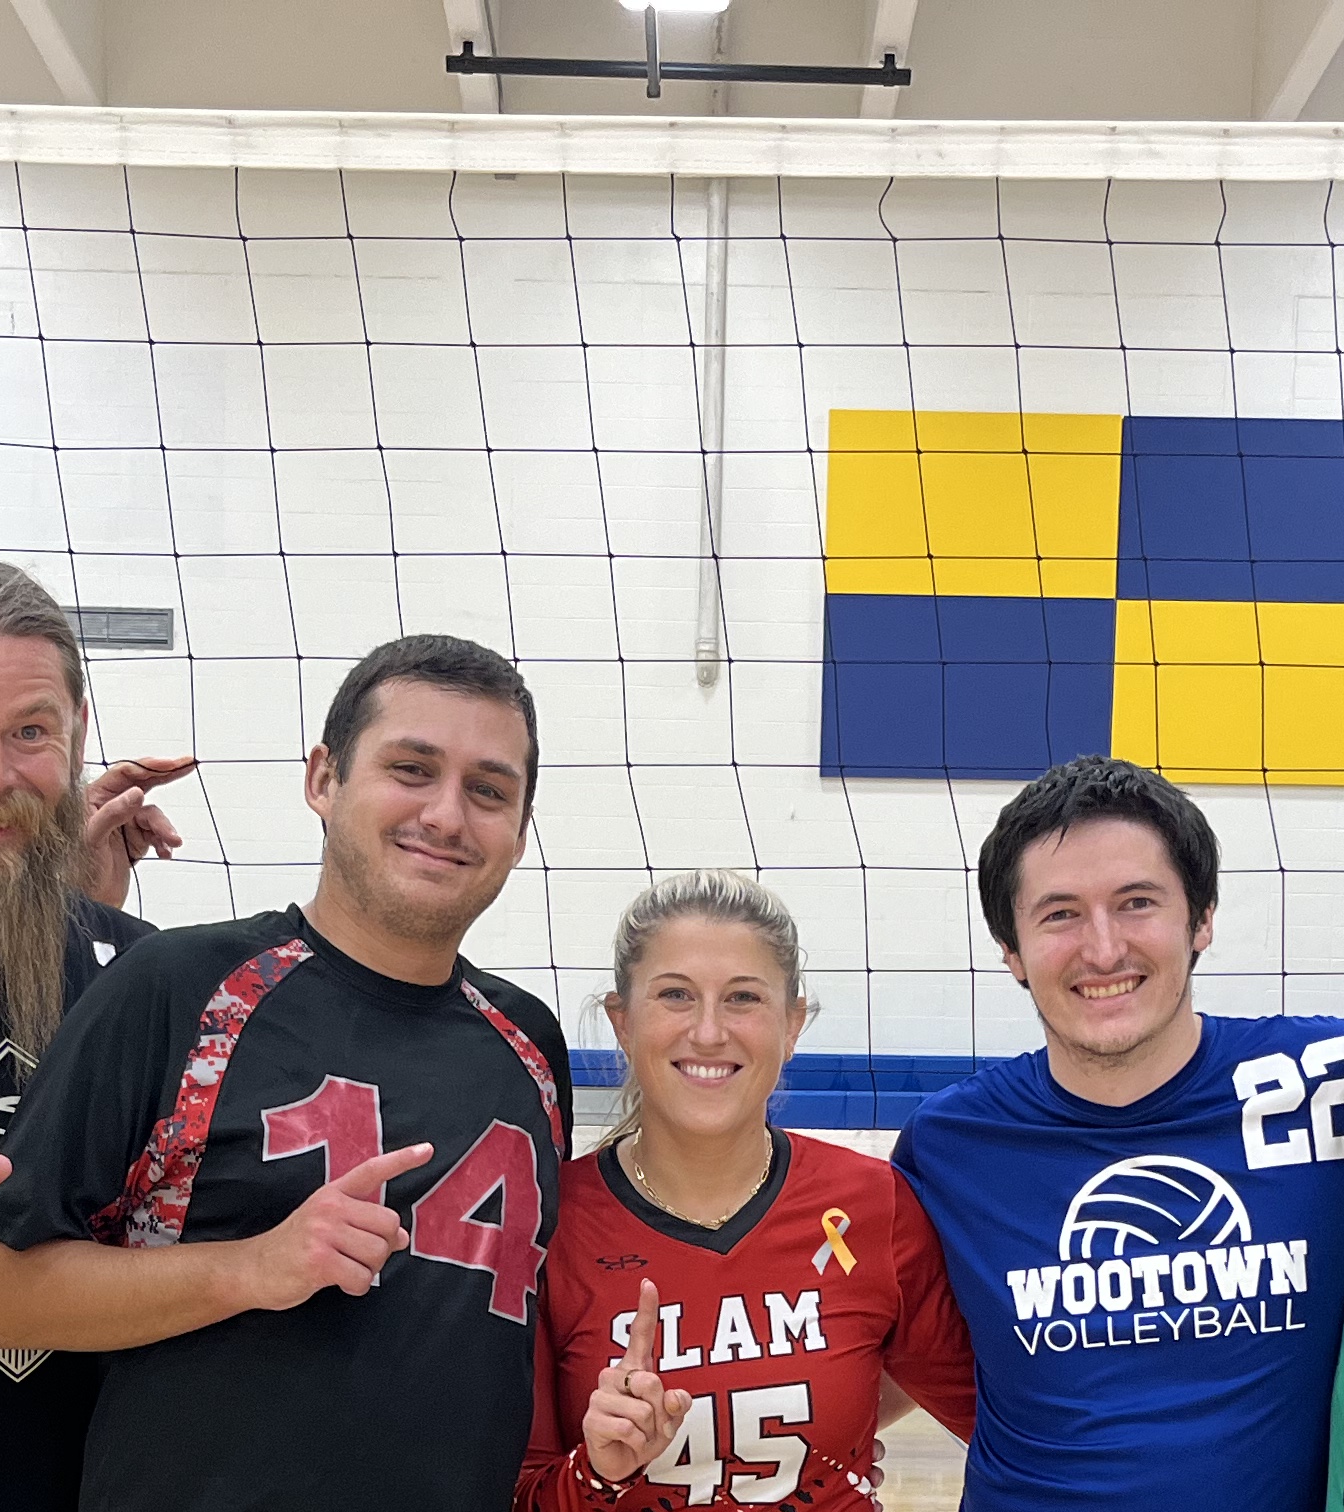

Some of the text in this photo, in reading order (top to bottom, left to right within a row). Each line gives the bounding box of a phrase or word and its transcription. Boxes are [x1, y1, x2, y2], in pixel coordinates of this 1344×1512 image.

[260, 1073, 548, 1327] 14
[1006, 1239, 1308, 1321] WOOTOWN
[1013, 1298, 1307, 1356] VOLLEYBALL
[642, 1380, 814, 1508] 45
